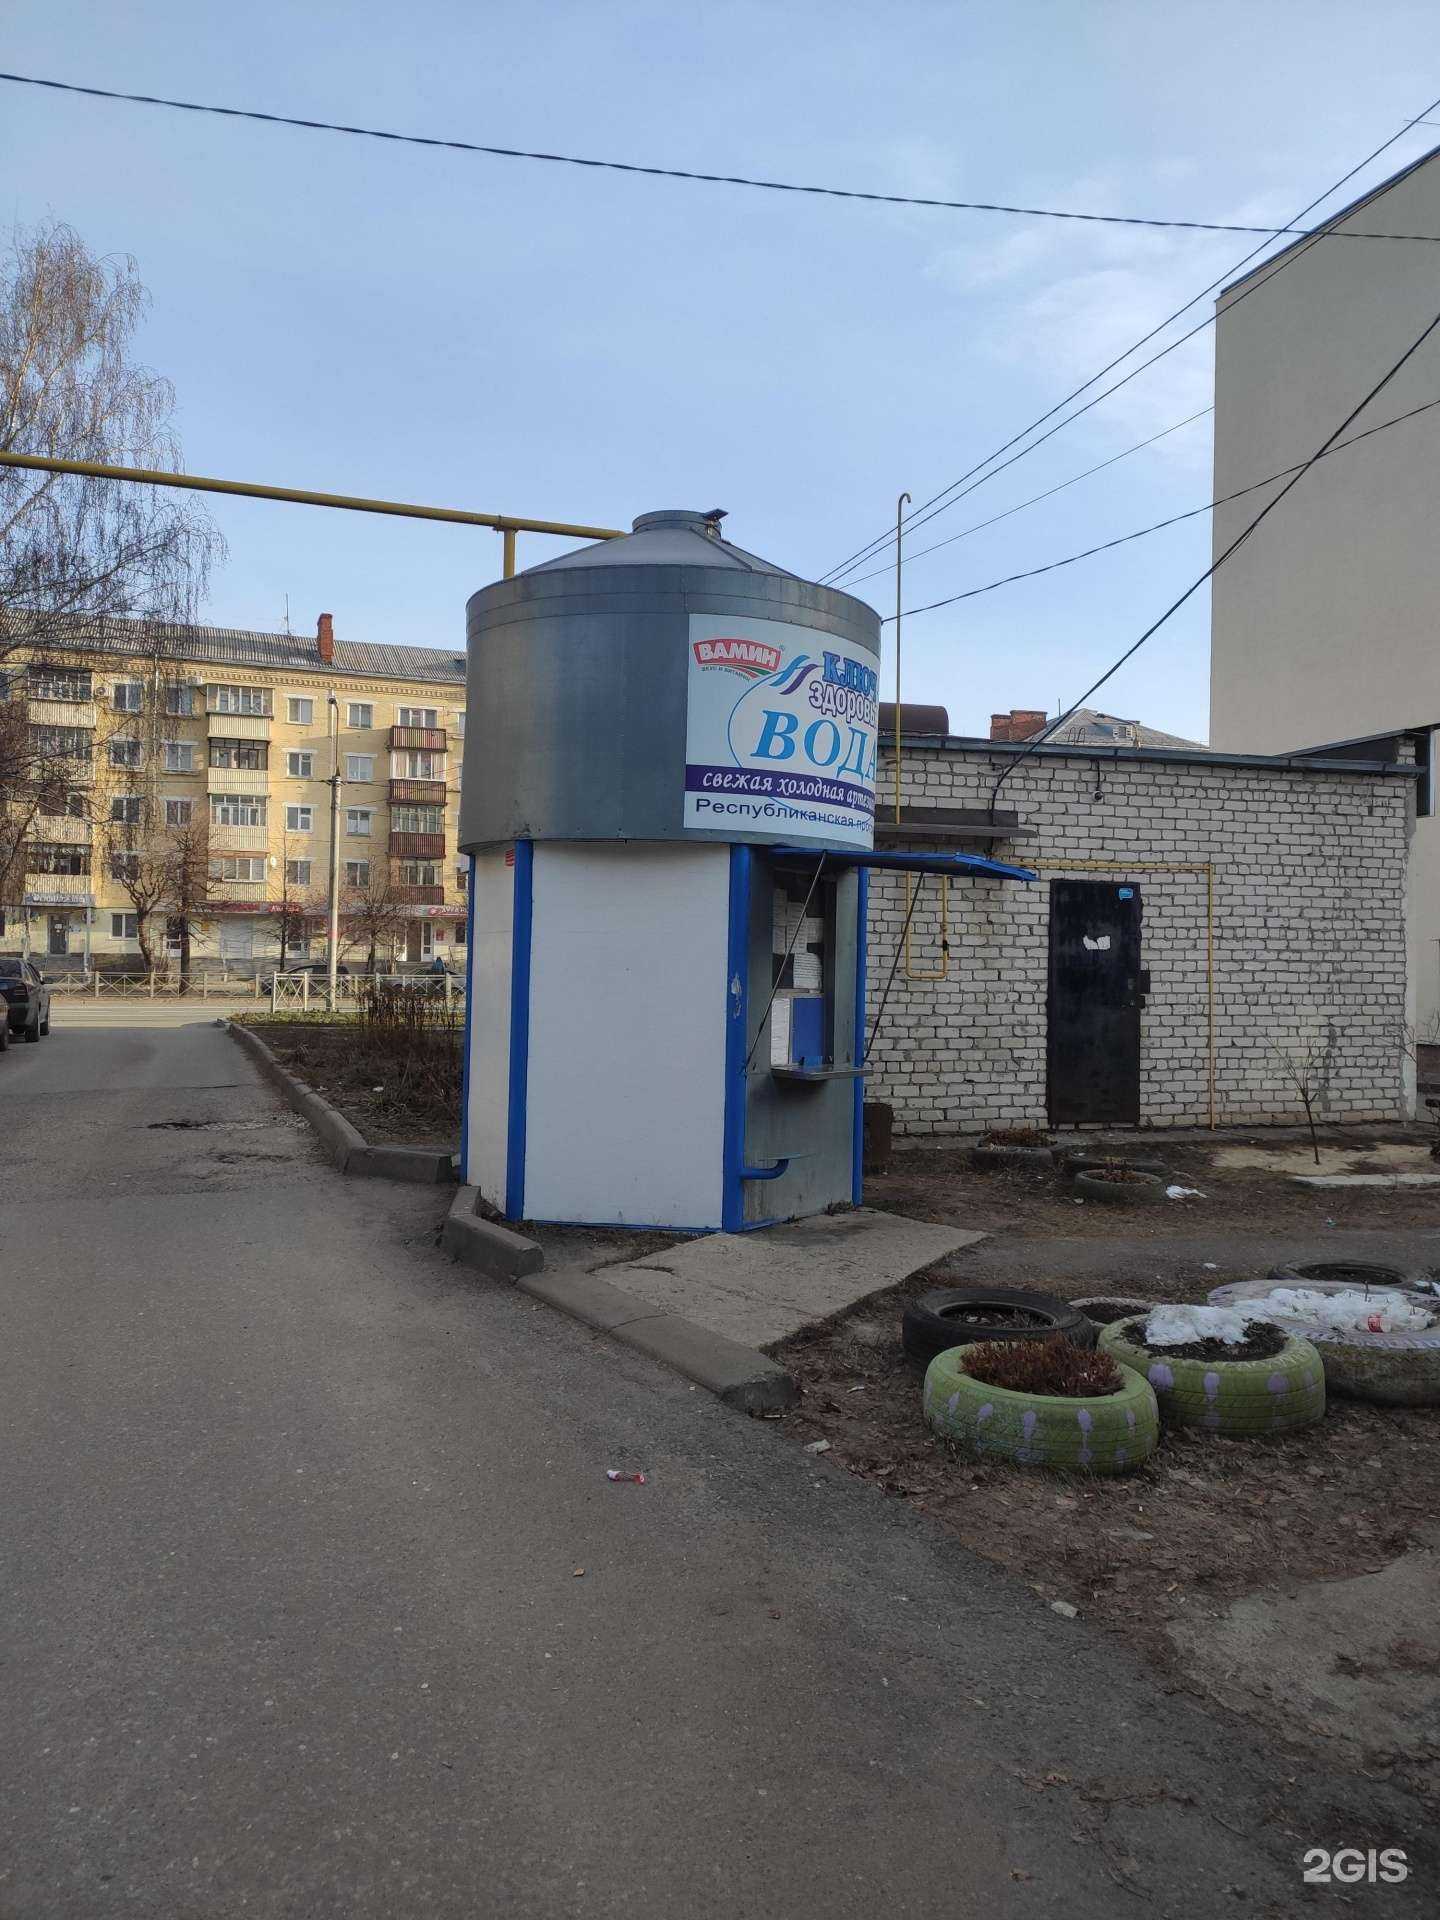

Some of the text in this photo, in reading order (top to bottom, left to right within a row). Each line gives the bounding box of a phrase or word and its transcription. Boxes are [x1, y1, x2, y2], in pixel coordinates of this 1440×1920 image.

[698, 642, 776, 665] ВАМИН
[750, 710, 875, 784] ВОДА
[702, 772, 773, 792] свежая
[776, 777, 845, 802] холодная
[695, 798, 853, 828] Республиканская
